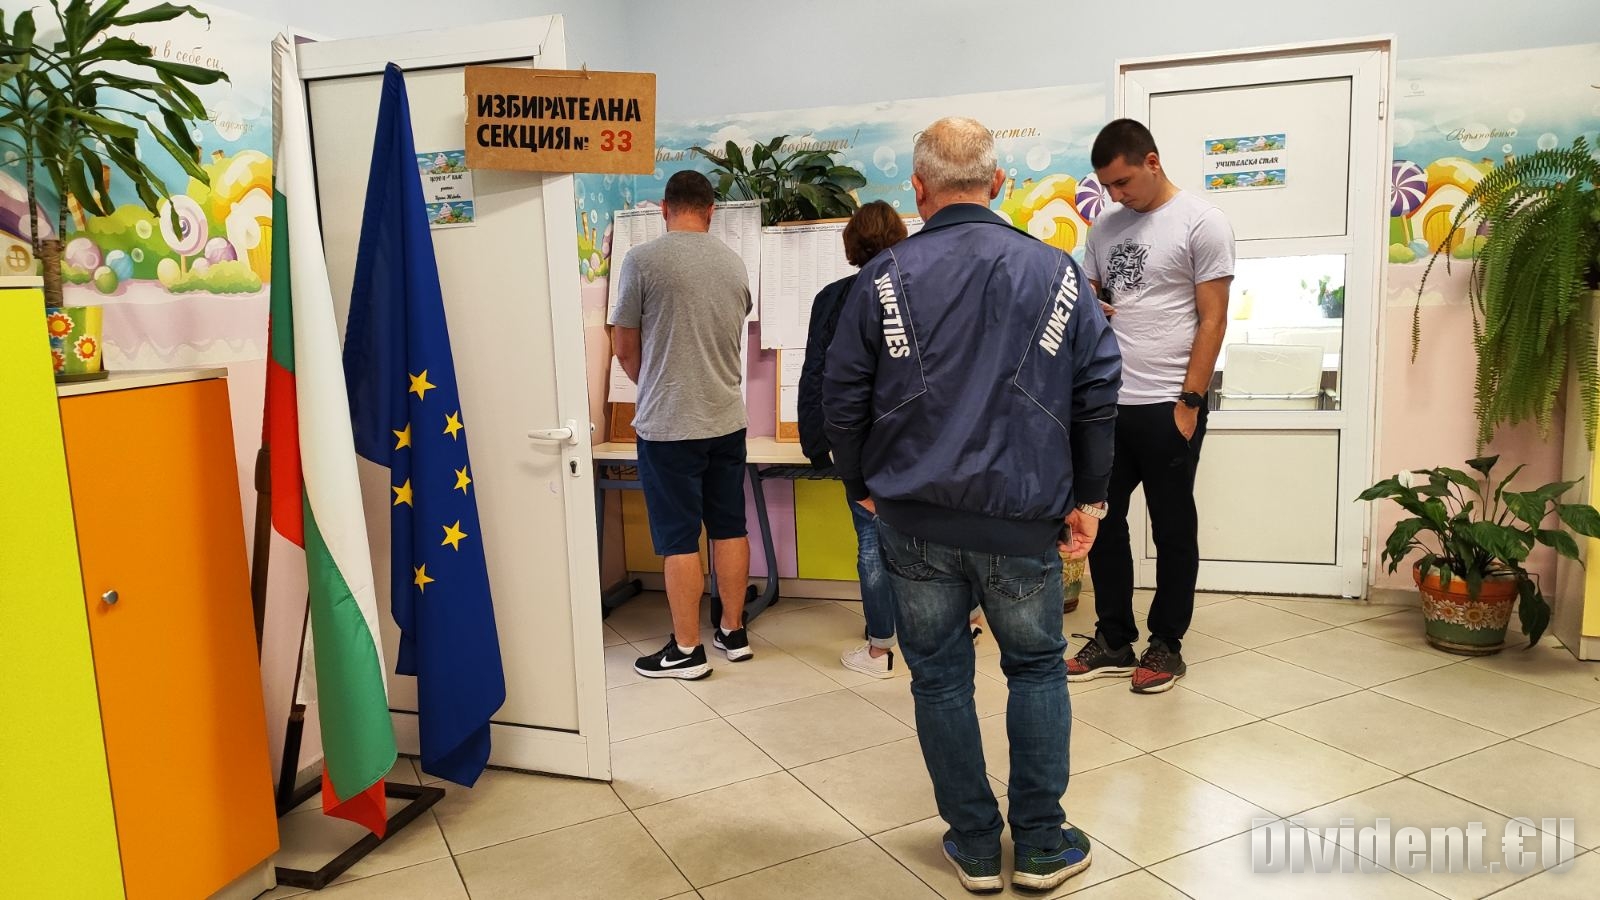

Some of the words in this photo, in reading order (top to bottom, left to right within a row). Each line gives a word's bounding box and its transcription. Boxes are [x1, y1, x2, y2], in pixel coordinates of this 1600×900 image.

[176, 46, 202, 65] себе
[477, 94, 642, 122] ИЗБИРАТЕЛНА
[476, 123, 571, 153] СЕКЦИЯ
[600, 129, 633, 152] 33
[1039, 265, 1079, 357] NINETIES
